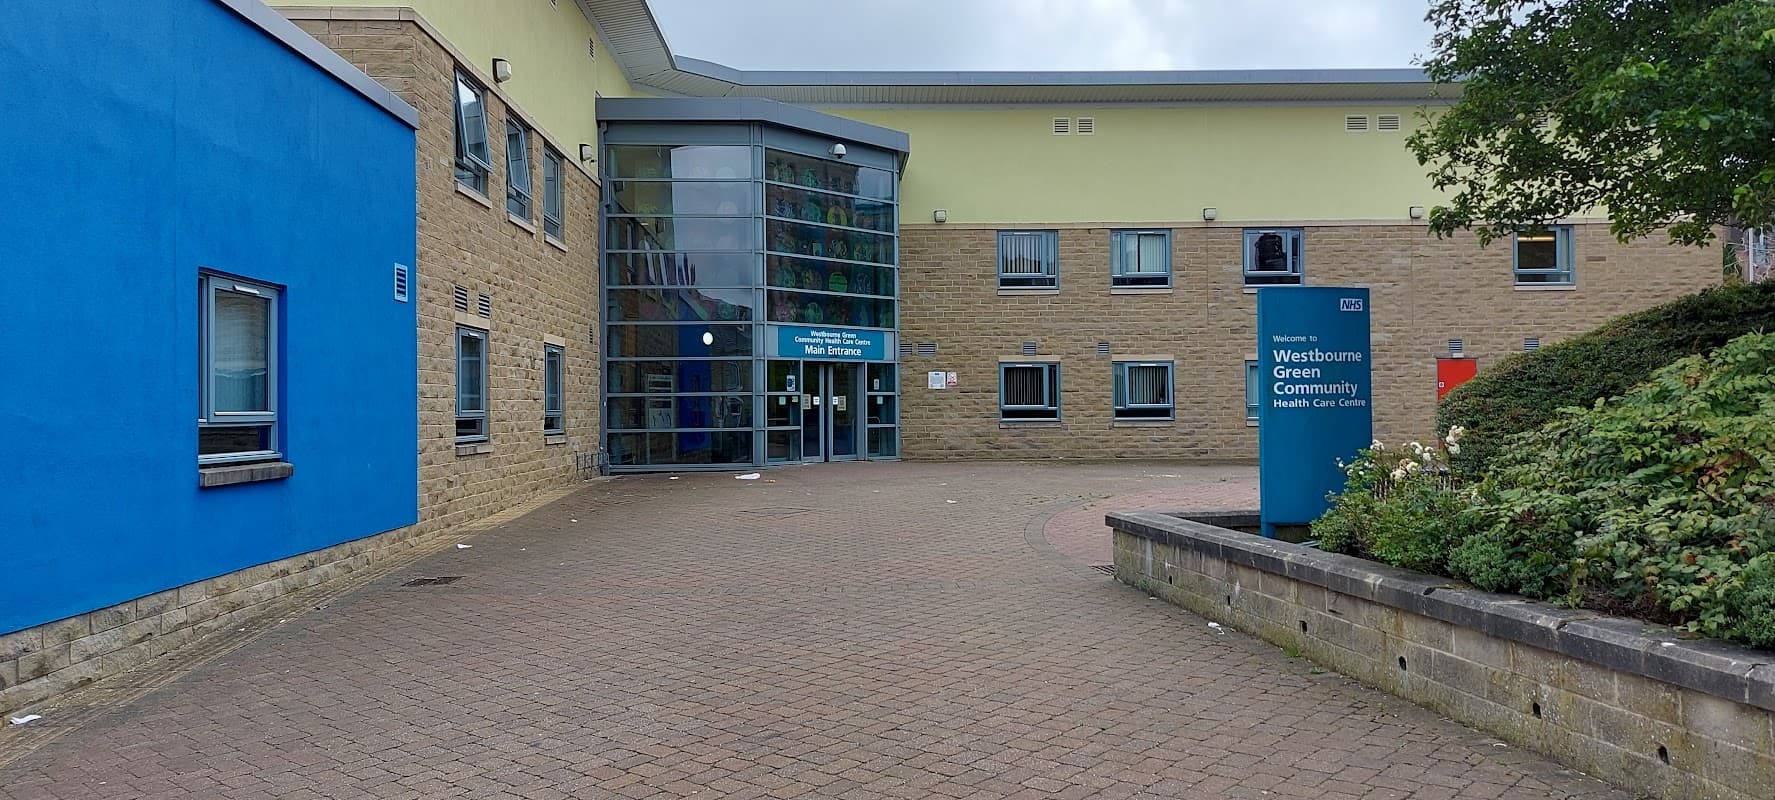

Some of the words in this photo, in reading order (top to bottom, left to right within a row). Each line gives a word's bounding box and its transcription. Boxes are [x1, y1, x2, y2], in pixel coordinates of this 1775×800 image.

[1341, 300, 1362, 310] NHS
[794, 335, 824, 345] Community
[825, 337, 841, 345] Health
[1273, 334, 1307, 342] Welcome
[804, 344, 825, 355] Main
[827, 345, 862, 356] Entrance
[1273, 348, 1362, 362] Westbourne
[1273, 365, 1321, 379] Green
[1273, 380, 1358, 397] Community
[1273, 398, 1310, 408] Health
[1313, 398, 1335, 407] Care
[1339, 398, 1366, 407] Centre
